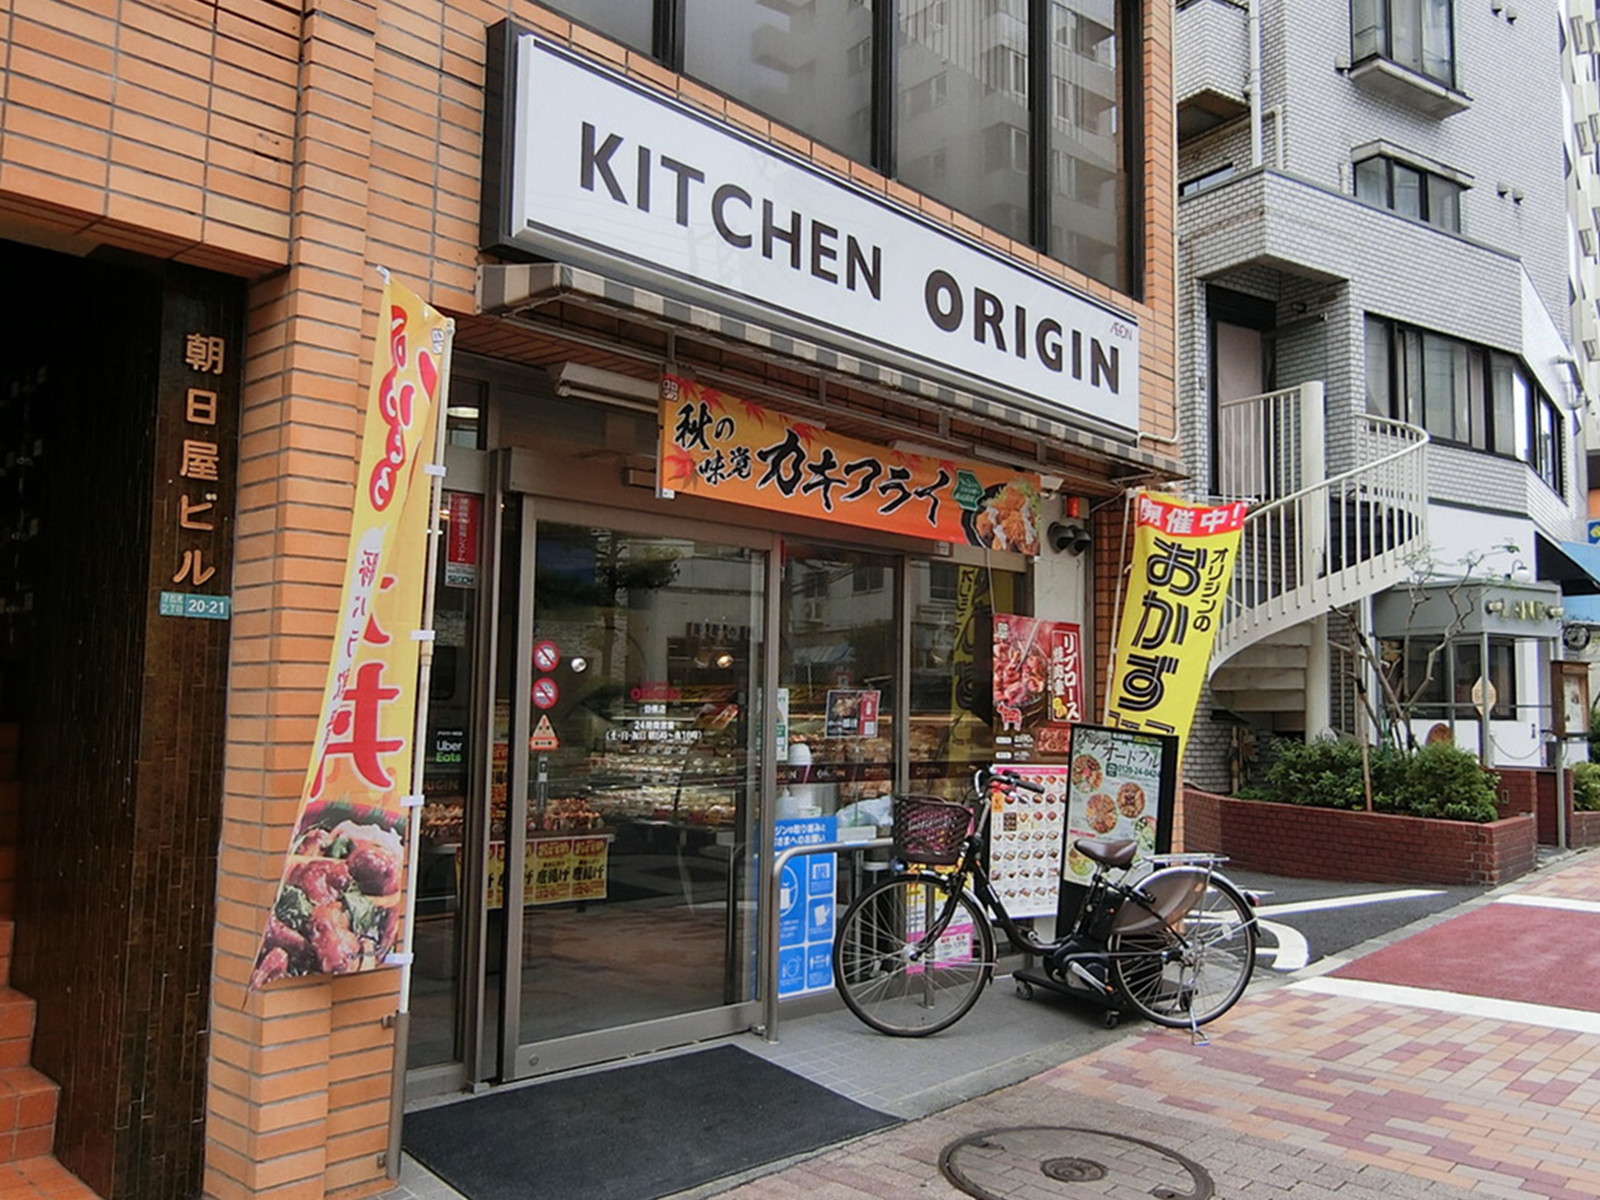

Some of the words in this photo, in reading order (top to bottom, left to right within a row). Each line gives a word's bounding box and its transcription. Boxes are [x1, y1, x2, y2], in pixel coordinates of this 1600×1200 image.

[580, 121, 881, 301] KITCHEN
[925, 269, 1119, 395] ORIGIN
[173, 333, 226, 585] 朝日屋ビル
[674, 401, 735, 451] 秋の
[699, 449, 752, 486] 味覚
[757, 430, 951, 527] カキフライ
[188, 599, 225, 614] 20-21
[1193, 547, 1228, 632] オリジンの
[1063, 634, 1080, 720] リブロース
[1109, 536, 1207, 735] おかず
[436, 741, 462, 751] Uber
[436, 752, 461, 762] Eats
